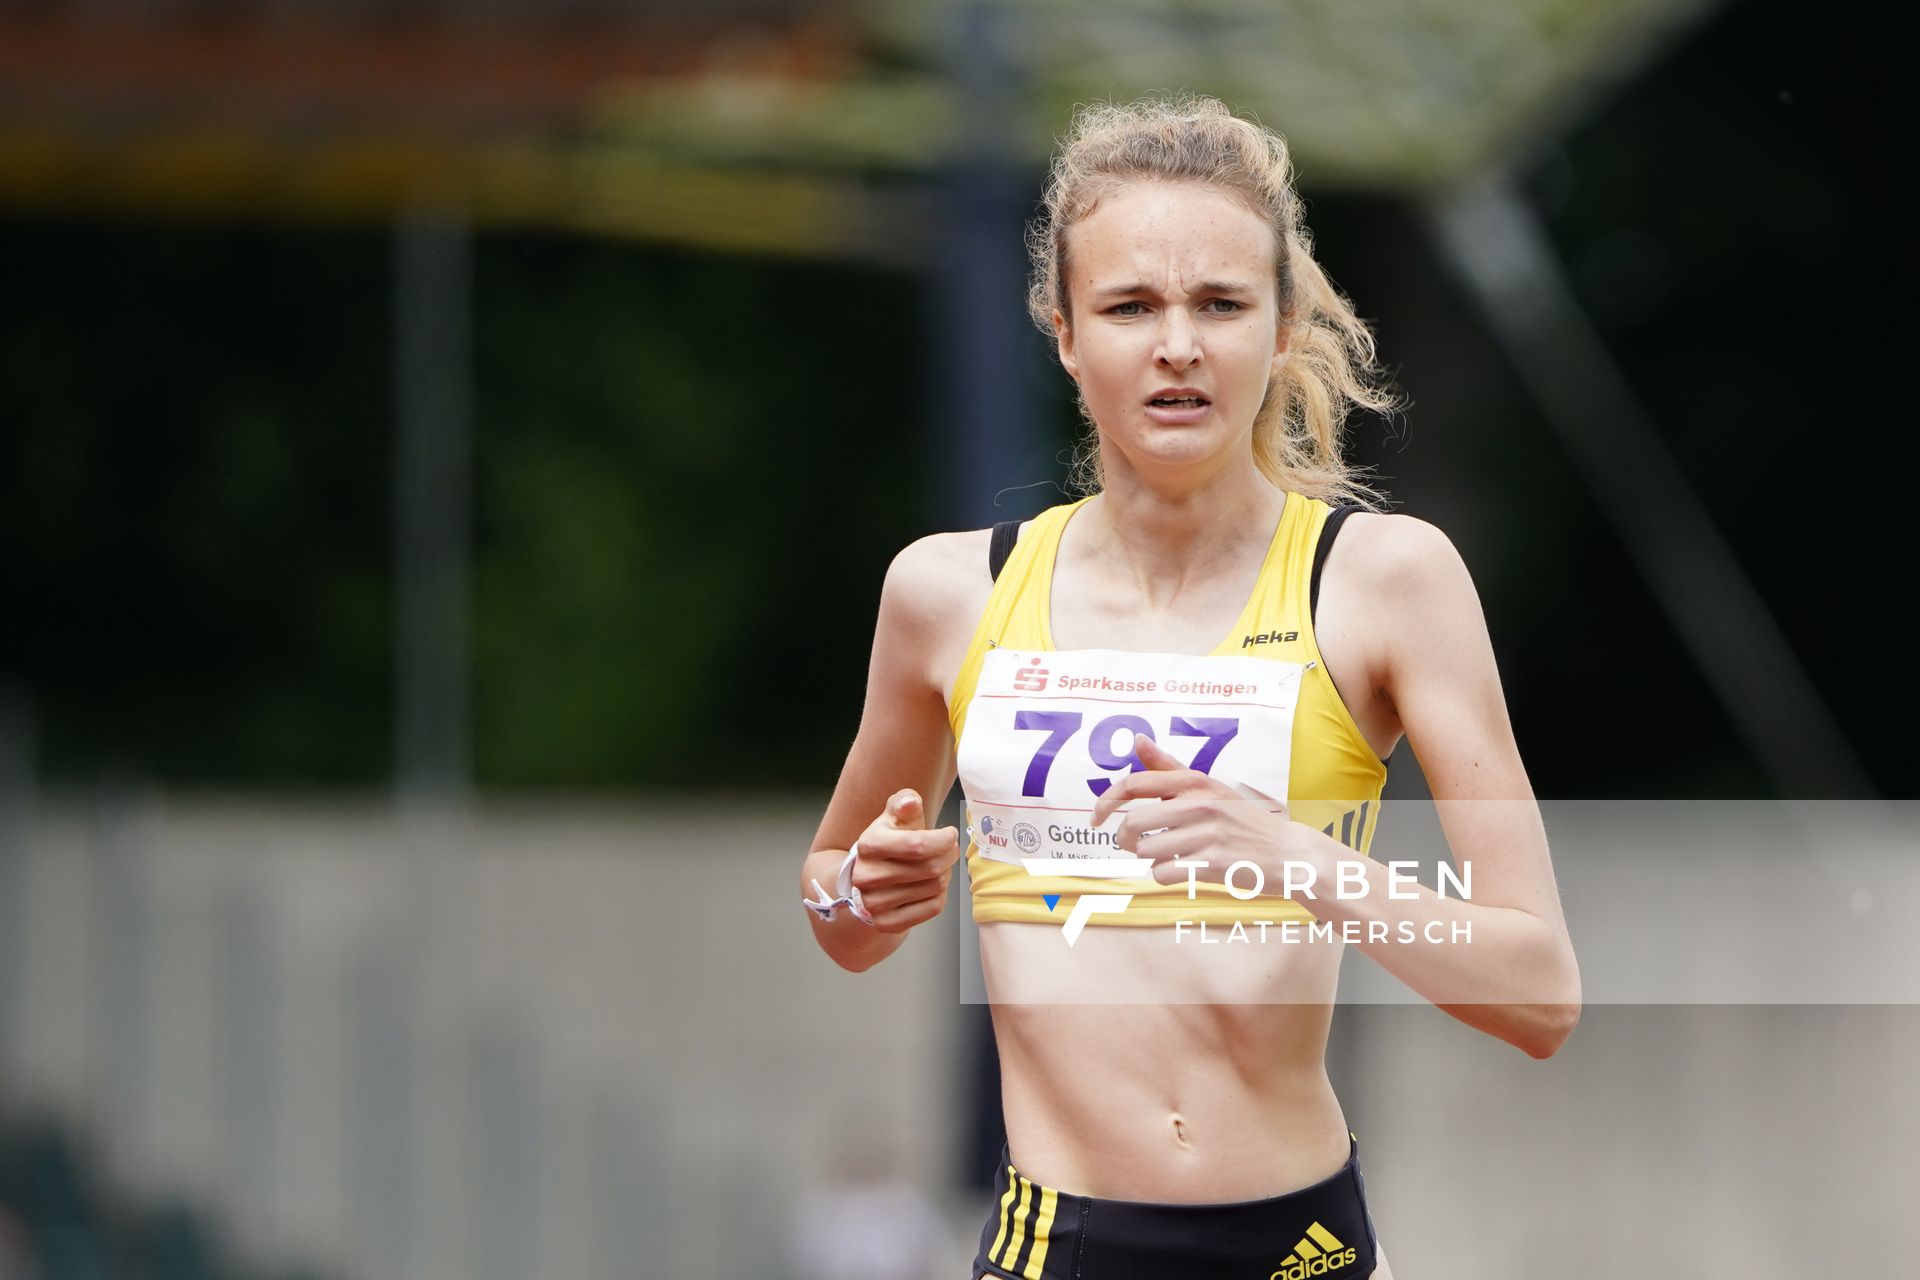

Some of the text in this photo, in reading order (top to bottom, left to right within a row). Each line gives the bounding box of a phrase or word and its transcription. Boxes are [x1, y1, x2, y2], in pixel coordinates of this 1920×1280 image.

[1057, 675, 1257, 697] Sparkasse Göttingen
[1013, 710, 1239, 799] 797
[989, 835, 1008, 848] NLV
[1270, 1247, 1357, 1280] adidas
